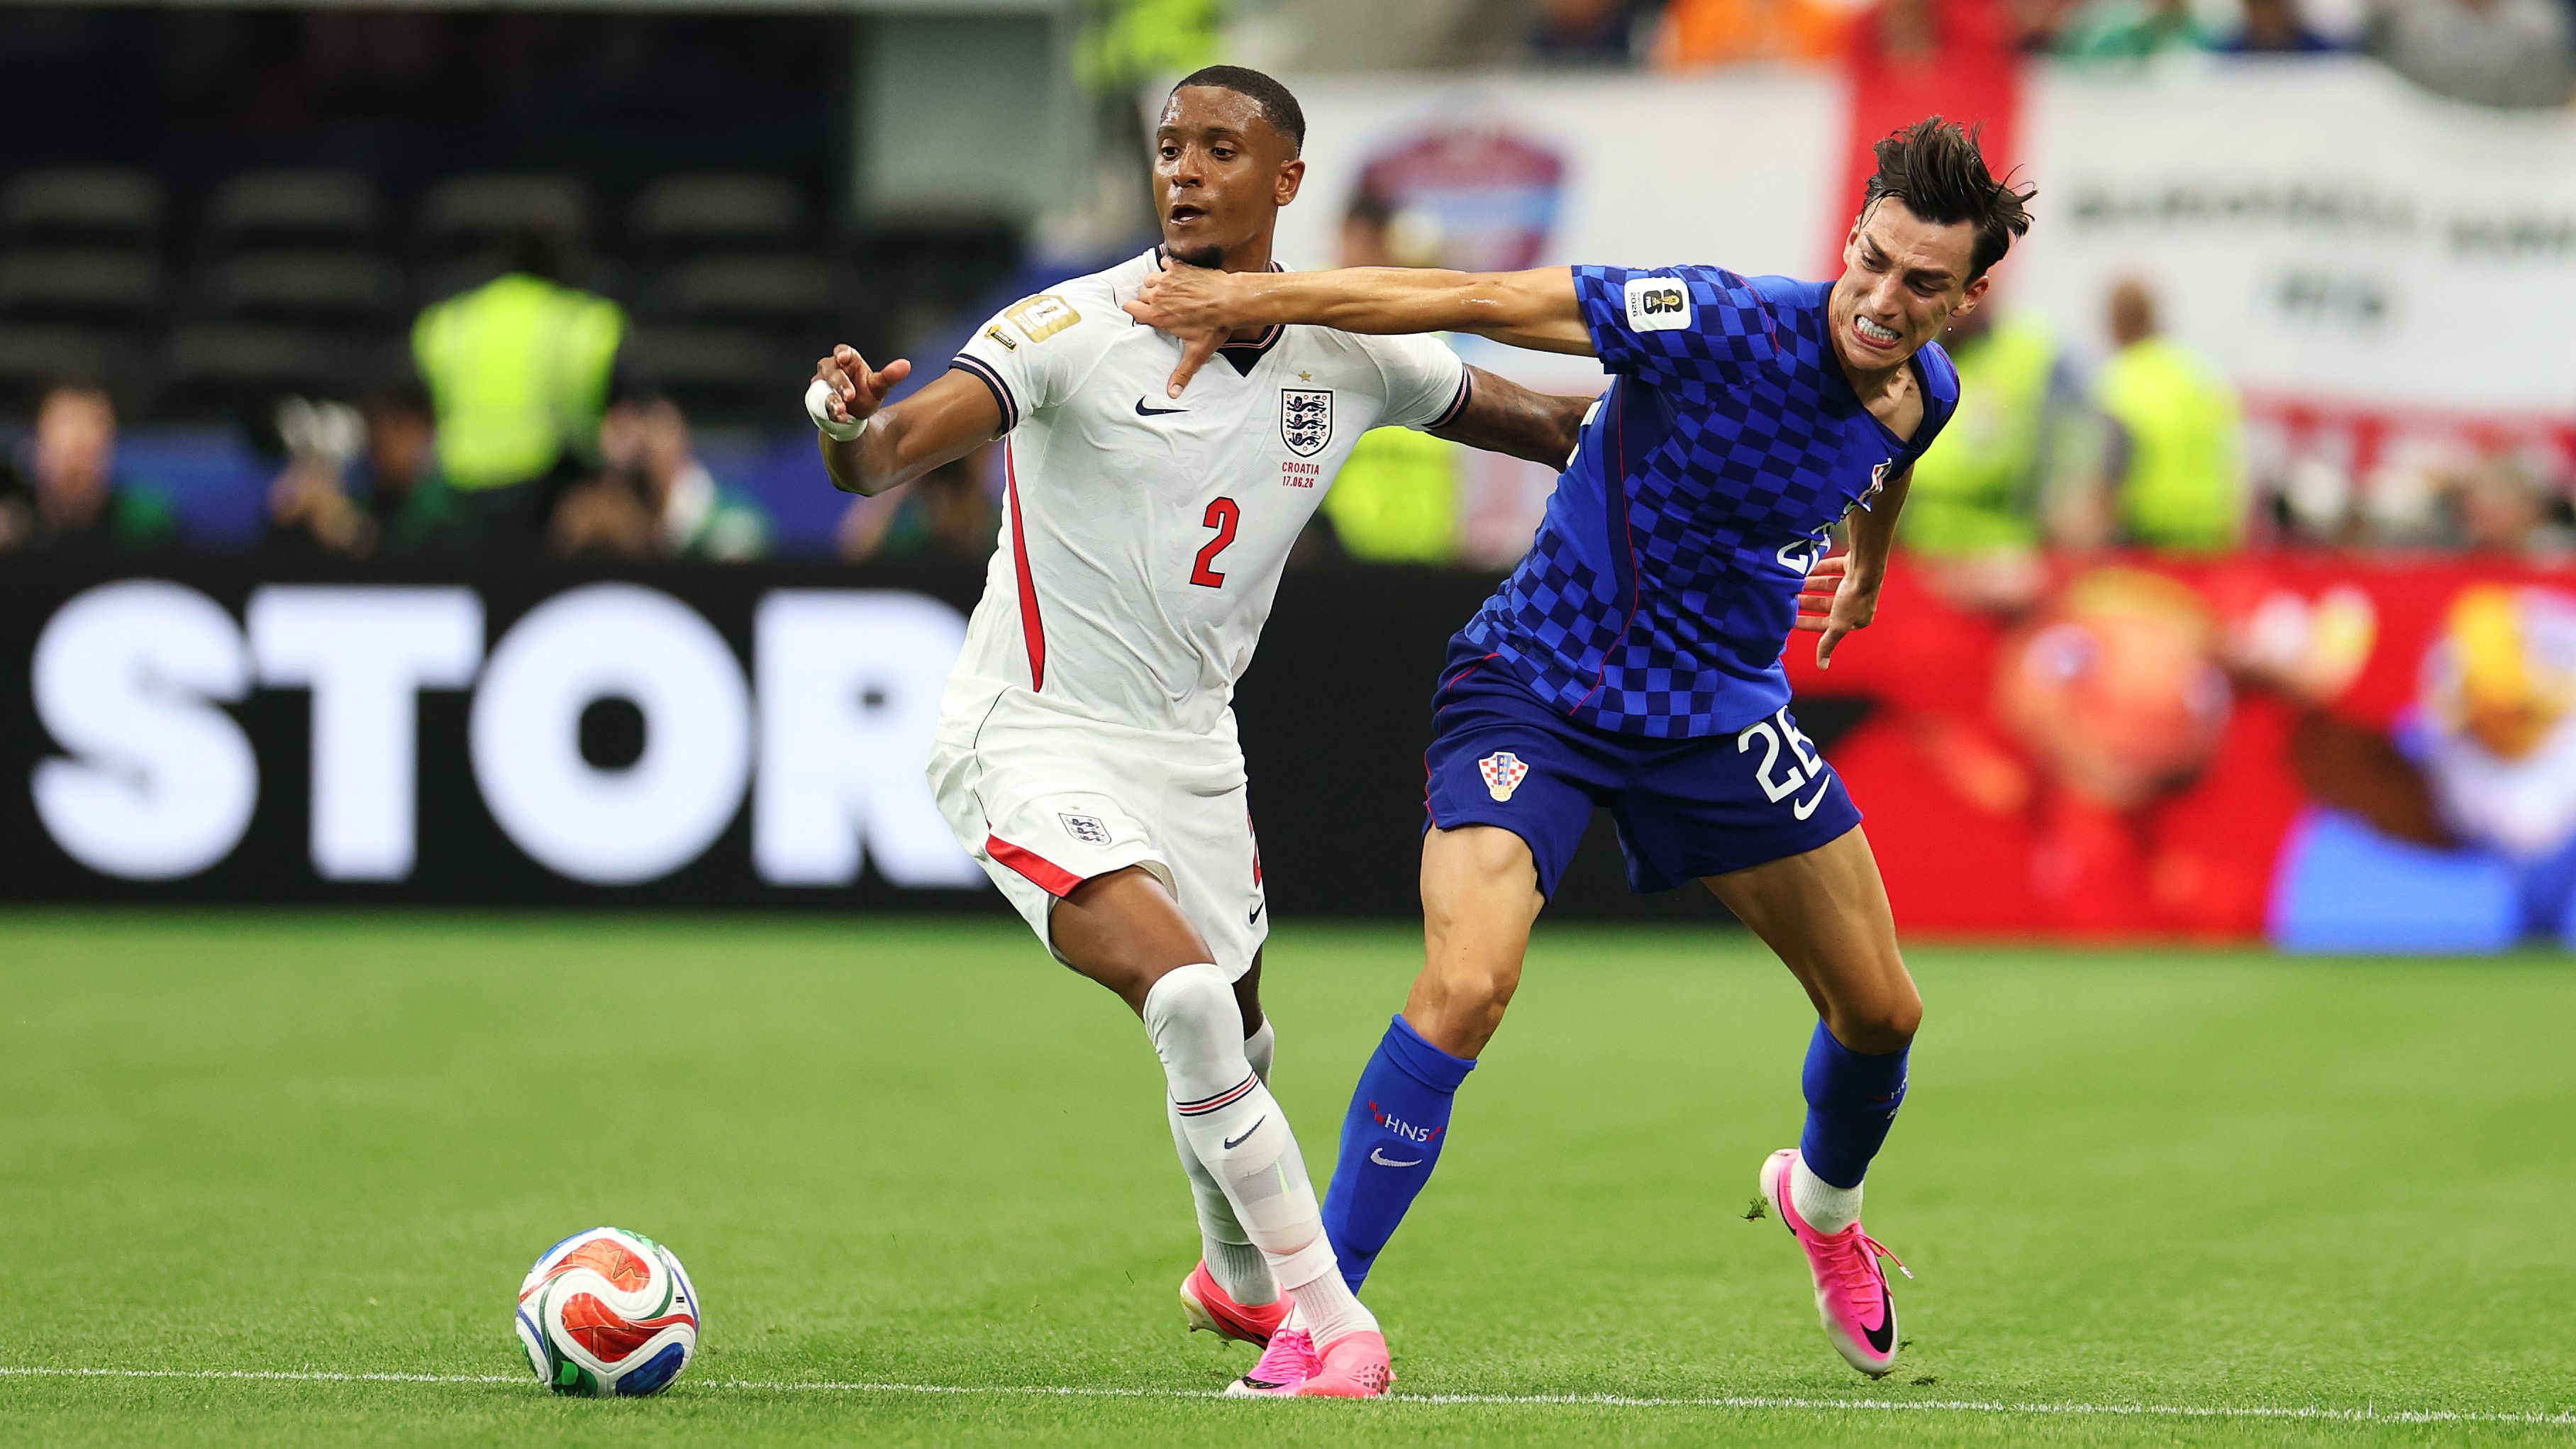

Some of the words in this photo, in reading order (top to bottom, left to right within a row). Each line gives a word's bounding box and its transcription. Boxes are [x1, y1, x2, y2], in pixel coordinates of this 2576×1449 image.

[1282, 462, 1320, 475] CROATIA
[1282, 476, 1314, 488] 17.06.26
[1189, 496, 1240, 589] 2
[1384, 1113, 1430, 1142] HNS
